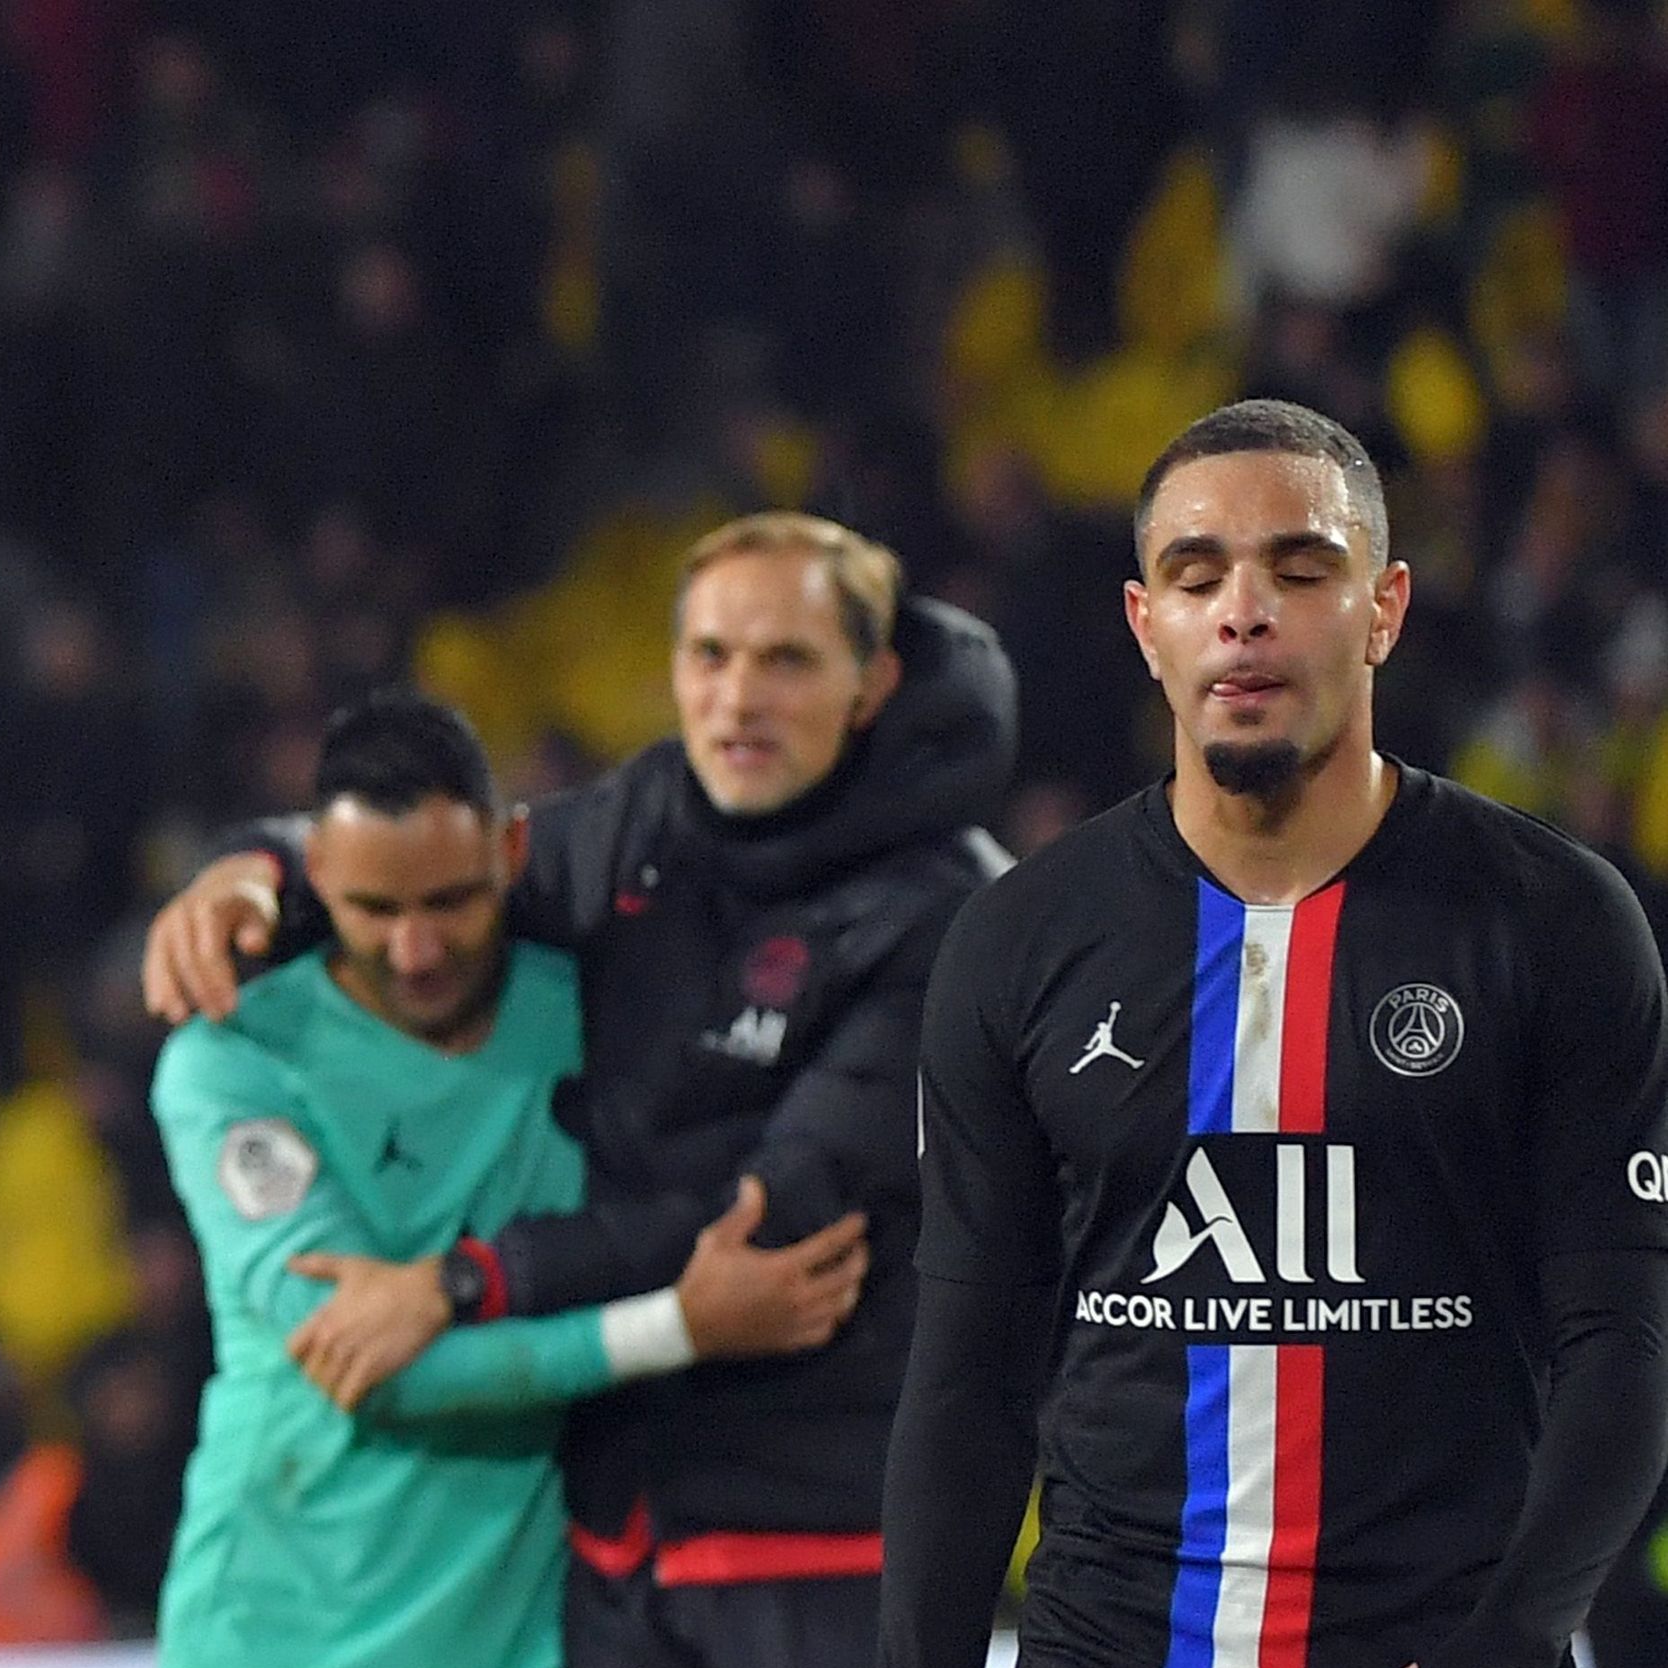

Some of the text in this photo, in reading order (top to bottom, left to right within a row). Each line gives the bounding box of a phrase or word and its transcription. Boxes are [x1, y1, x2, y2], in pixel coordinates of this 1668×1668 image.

[1388, 988, 1450, 1013] PARIS
[1627, 1150, 1668, 1203] Q
[1075, 1290, 1474, 1332] ACCOR LIVE LIMITLESS
